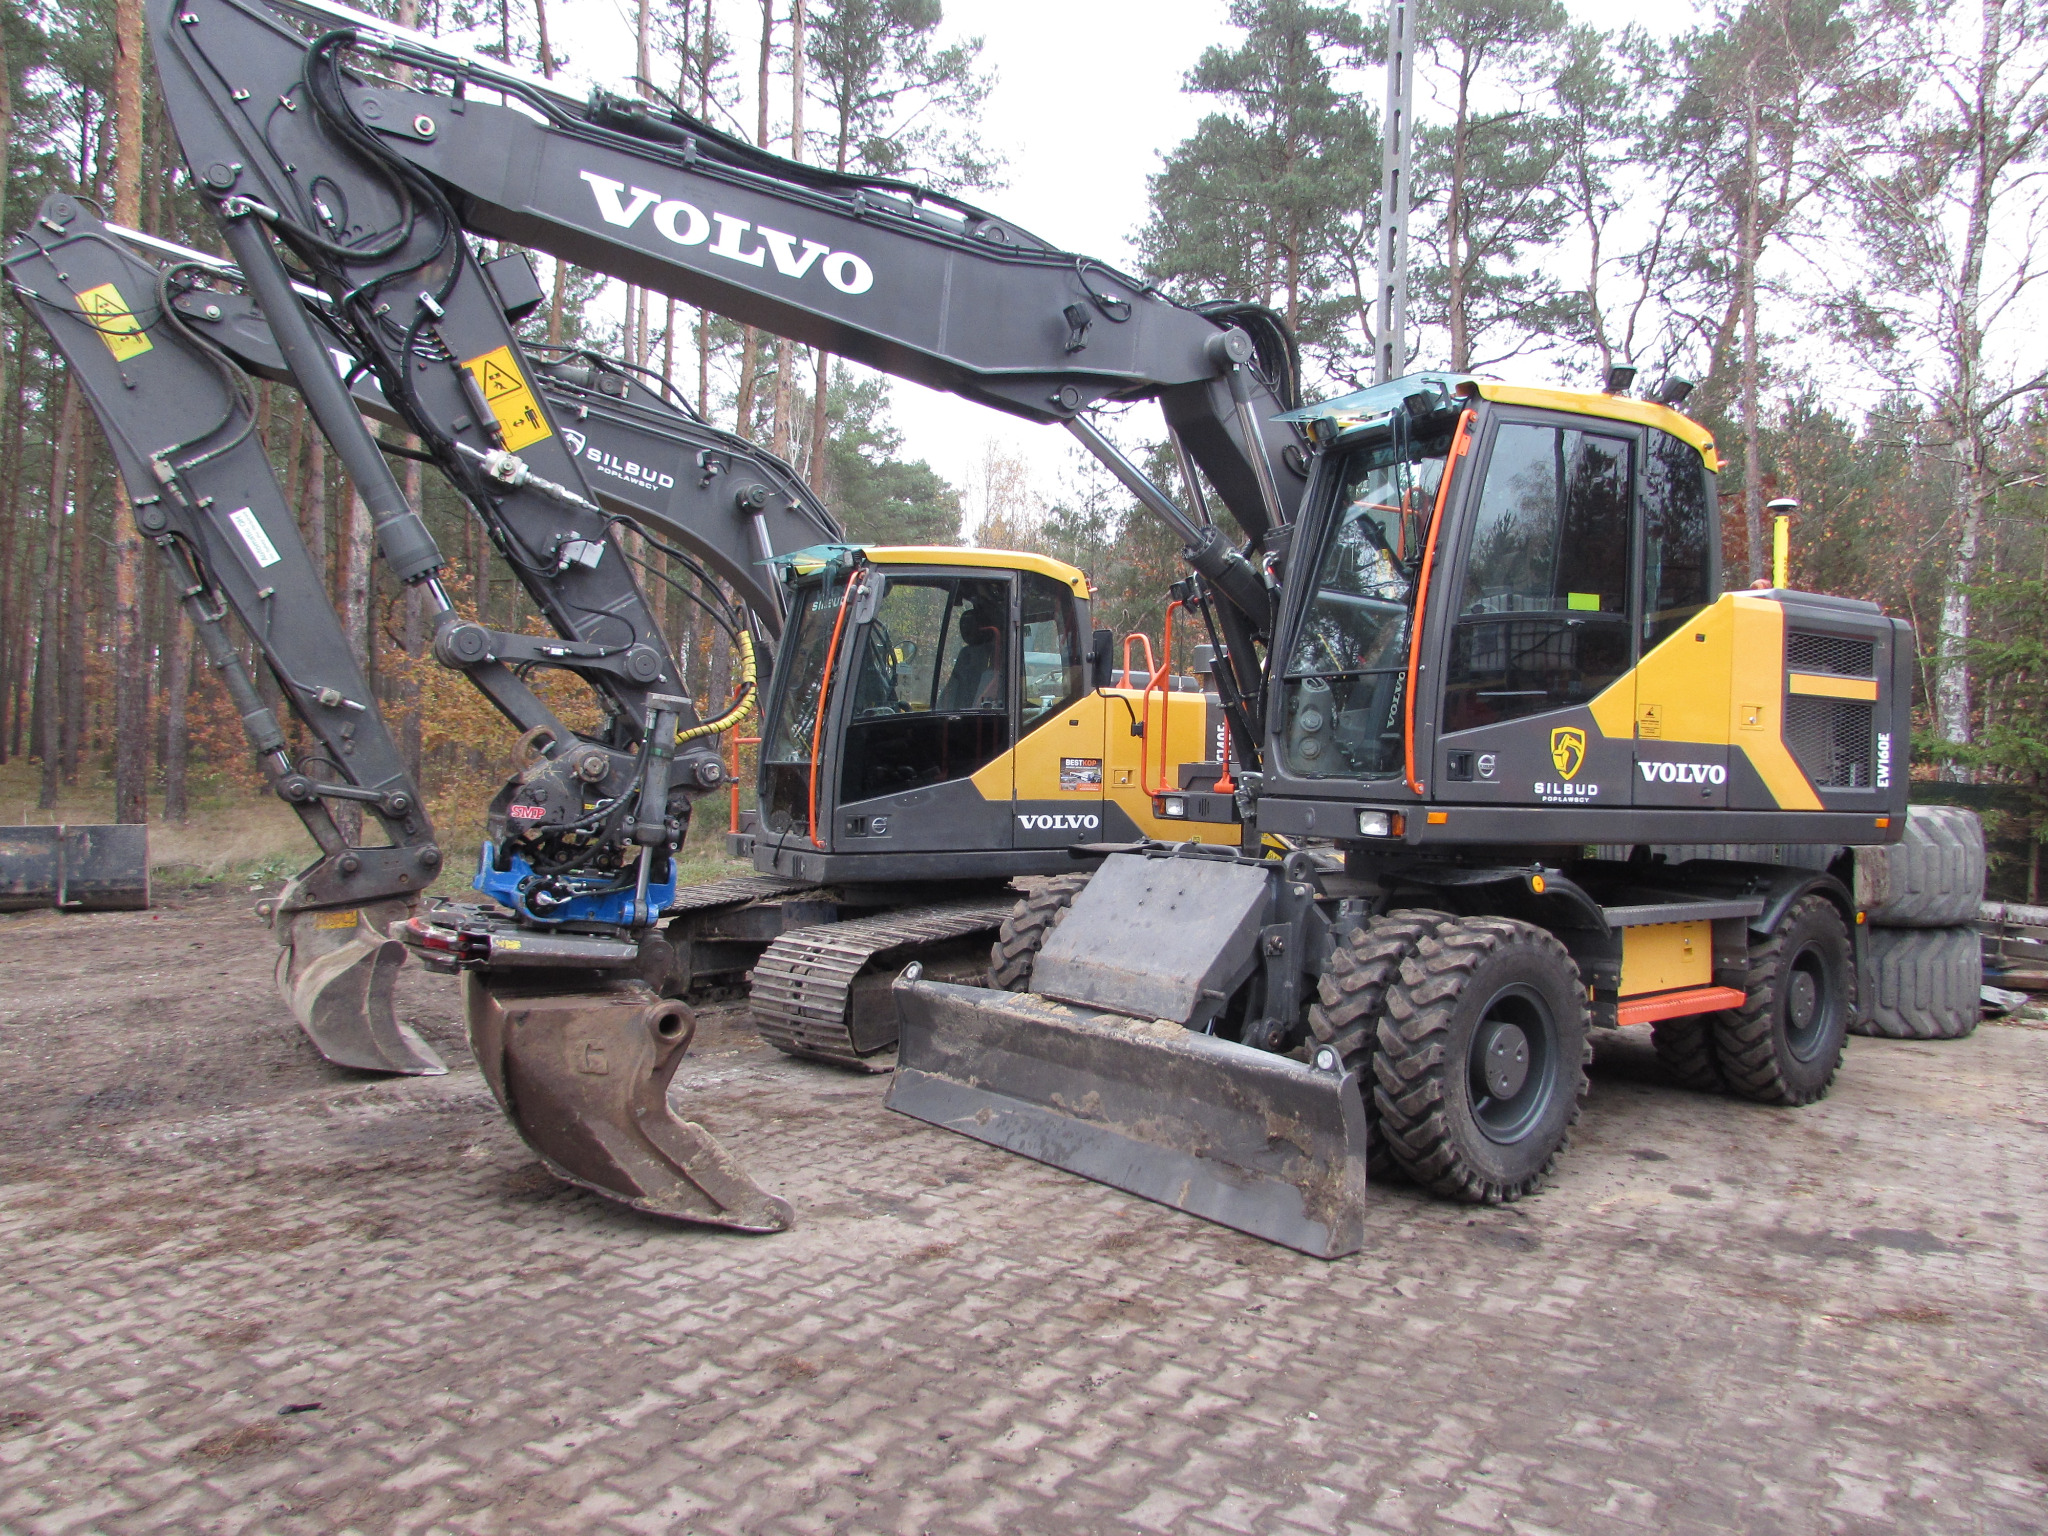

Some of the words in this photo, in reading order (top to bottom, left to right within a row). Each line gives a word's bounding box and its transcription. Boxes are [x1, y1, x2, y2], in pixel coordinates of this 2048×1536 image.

[579, 169, 874, 295] VOLVO
[586, 447, 675, 489] SILBUD
[1386, 672, 1405, 728] VOLVO
[1065, 758, 1097, 767] BESTKOP
[1877, 732, 1890, 787] EW160E
[1638, 761, 1726, 784] VOLVO
[1534, 782, 1598, 796] SILBUD
[511, 804, 546, 820] SMP
[1018, 814, 1099, 829] VOLVO
